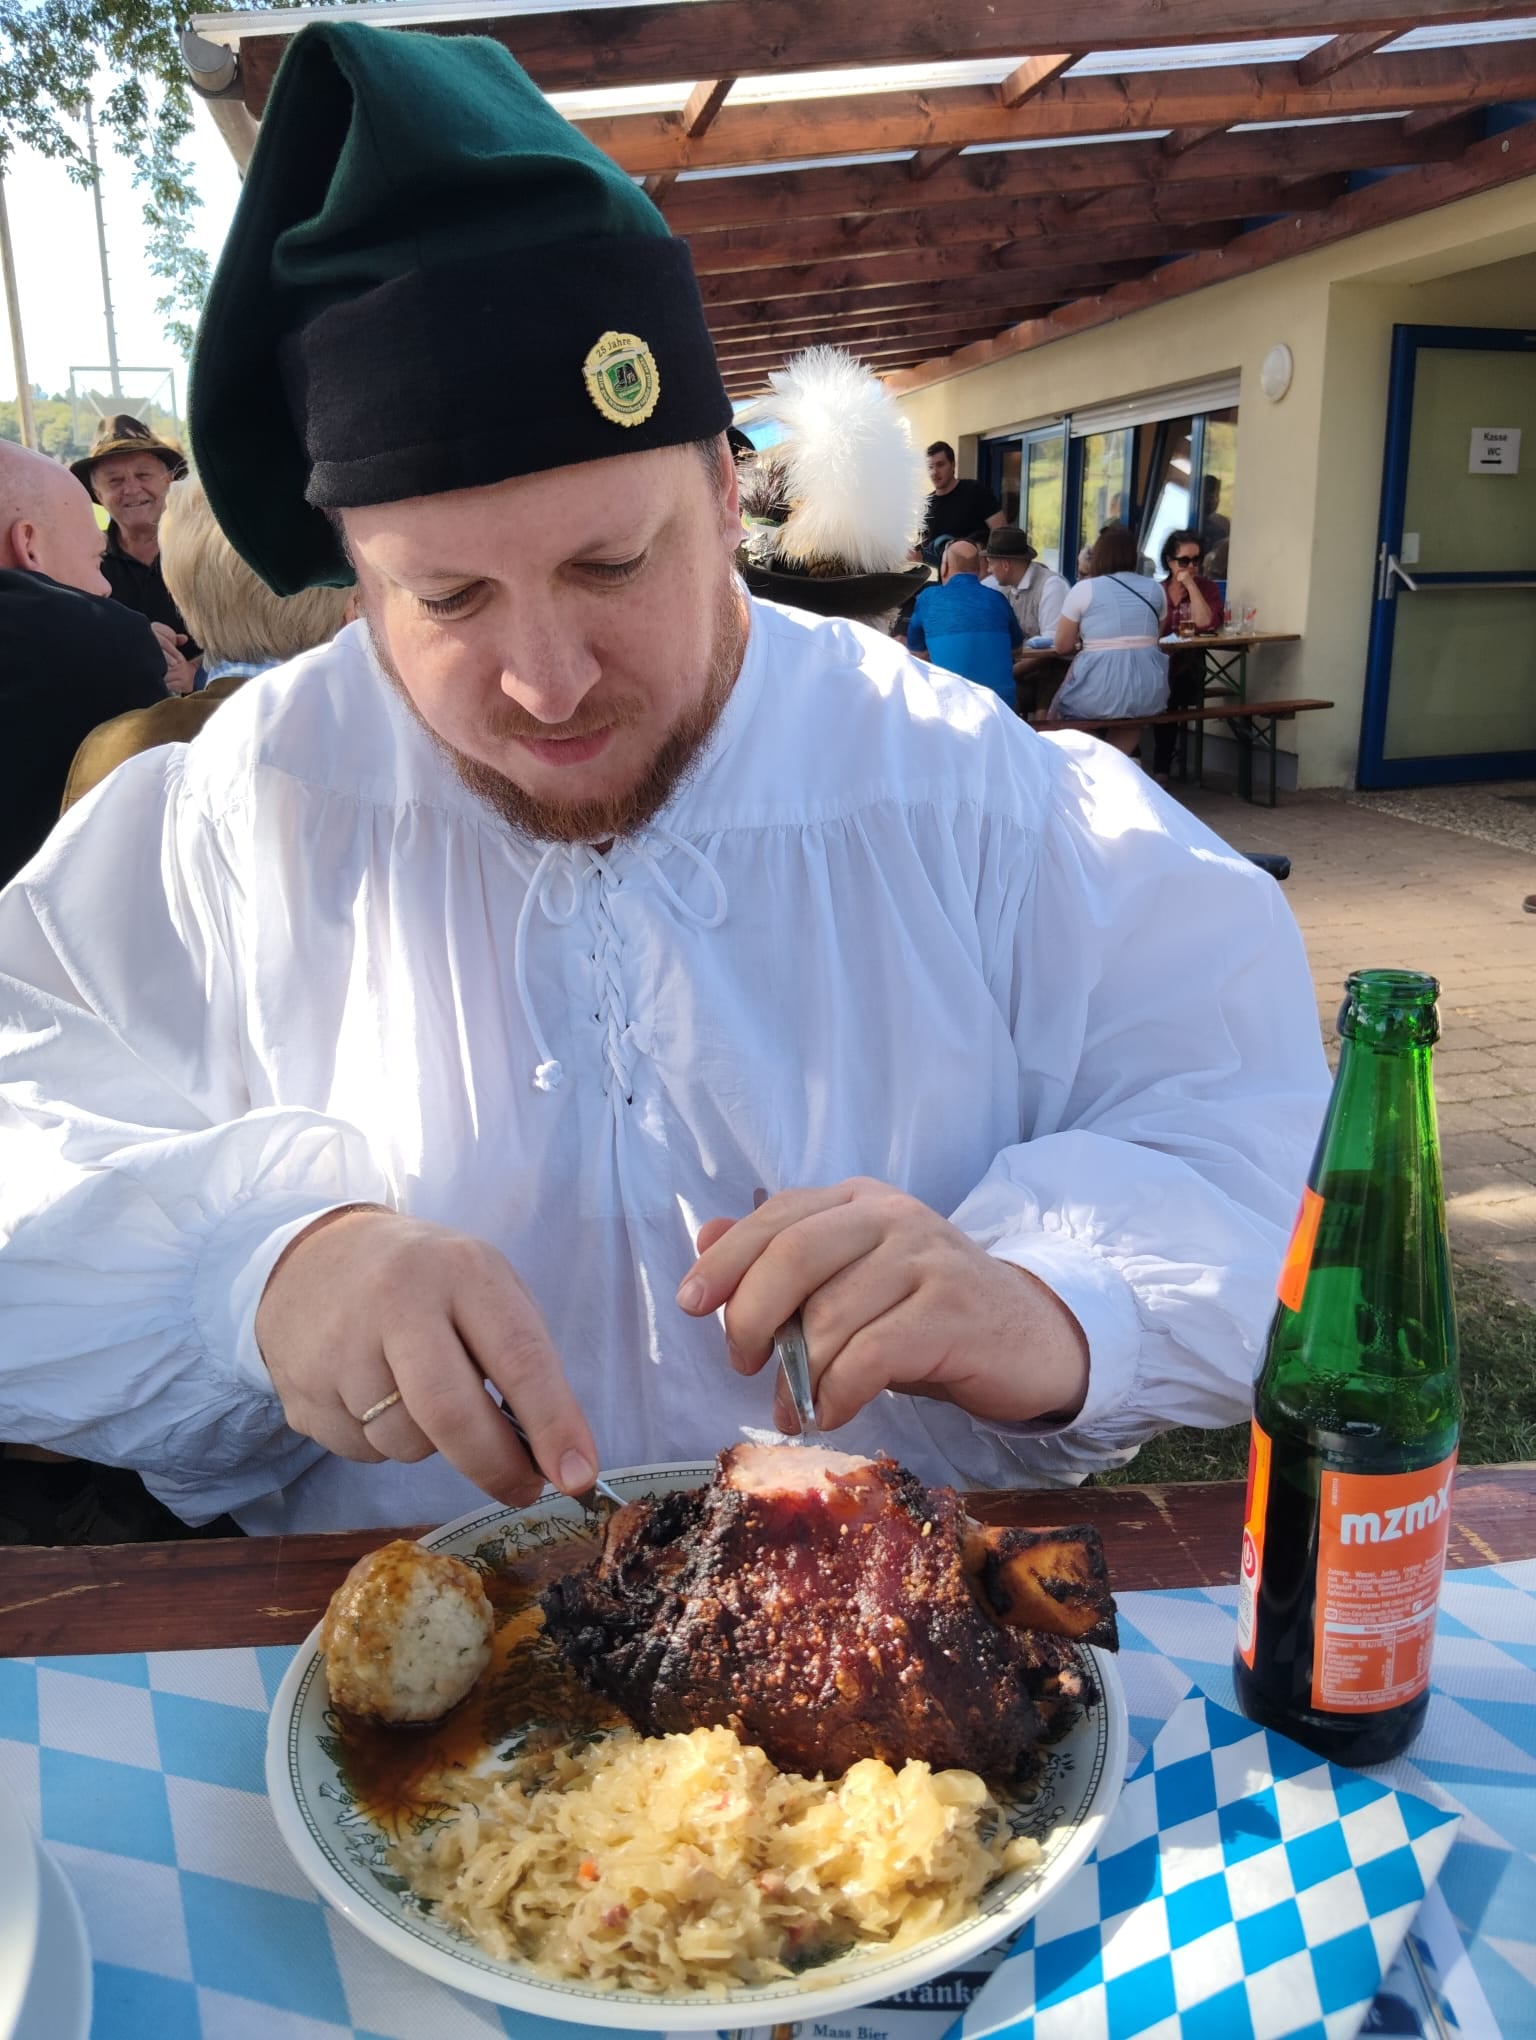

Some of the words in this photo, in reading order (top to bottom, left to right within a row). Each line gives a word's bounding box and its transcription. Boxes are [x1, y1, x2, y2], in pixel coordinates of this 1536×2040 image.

[608, 337, 632, 351] Jahre
[1483, 432, 1508, 441] Kasse
[1487, 447, 1502, 456] WC
[857, 2026, 889, 2040] Bier
